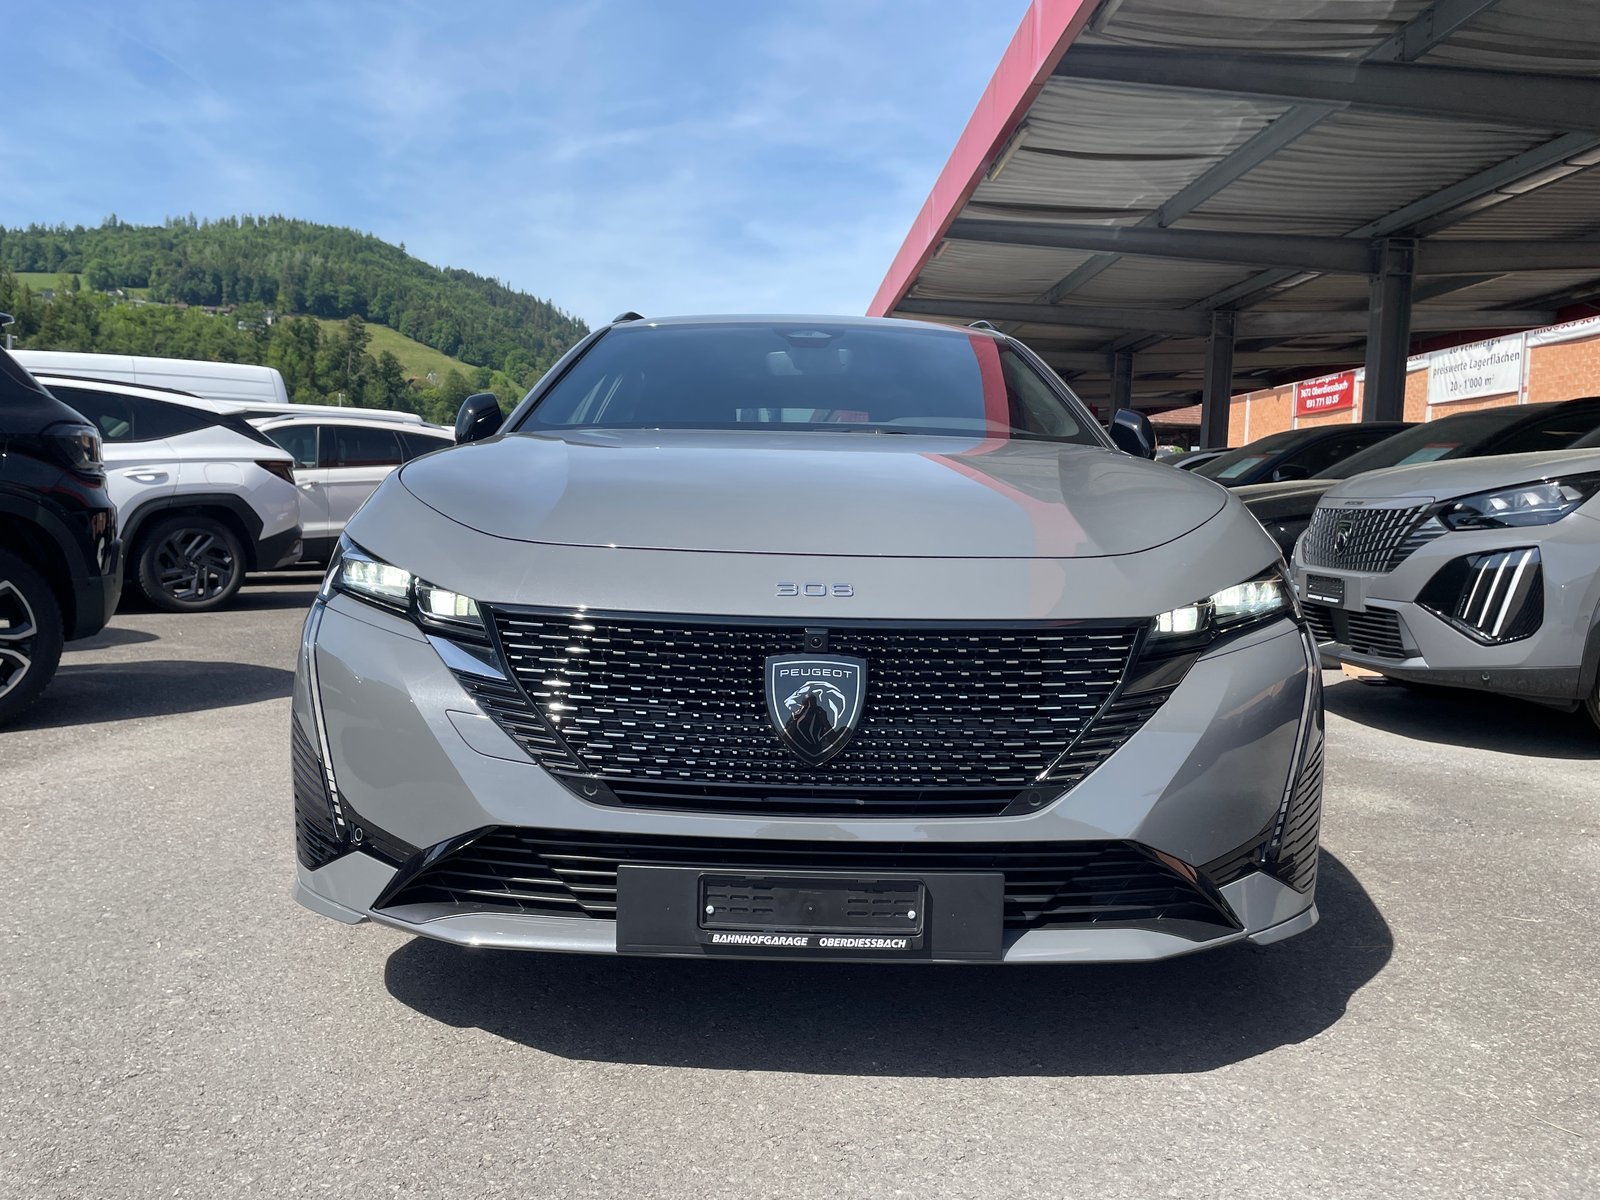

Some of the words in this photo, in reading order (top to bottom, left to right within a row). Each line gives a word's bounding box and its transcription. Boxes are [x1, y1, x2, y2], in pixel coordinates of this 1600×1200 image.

[1432, 361, 1467, 379] preiswerte
[1469, 351, 1520, 372] Lagerflächen
[1450, 380, 1457, 392] 20
[1464, 376, 1483, 389] 1'000
[776, 582, 854, 597] 308
[779, 668, 853, 678] PEUGEOT
[711, 934, 808, 946] BAHNHOFGARAGE
[819, 937, 907, 948] OBERDIESSBACH
